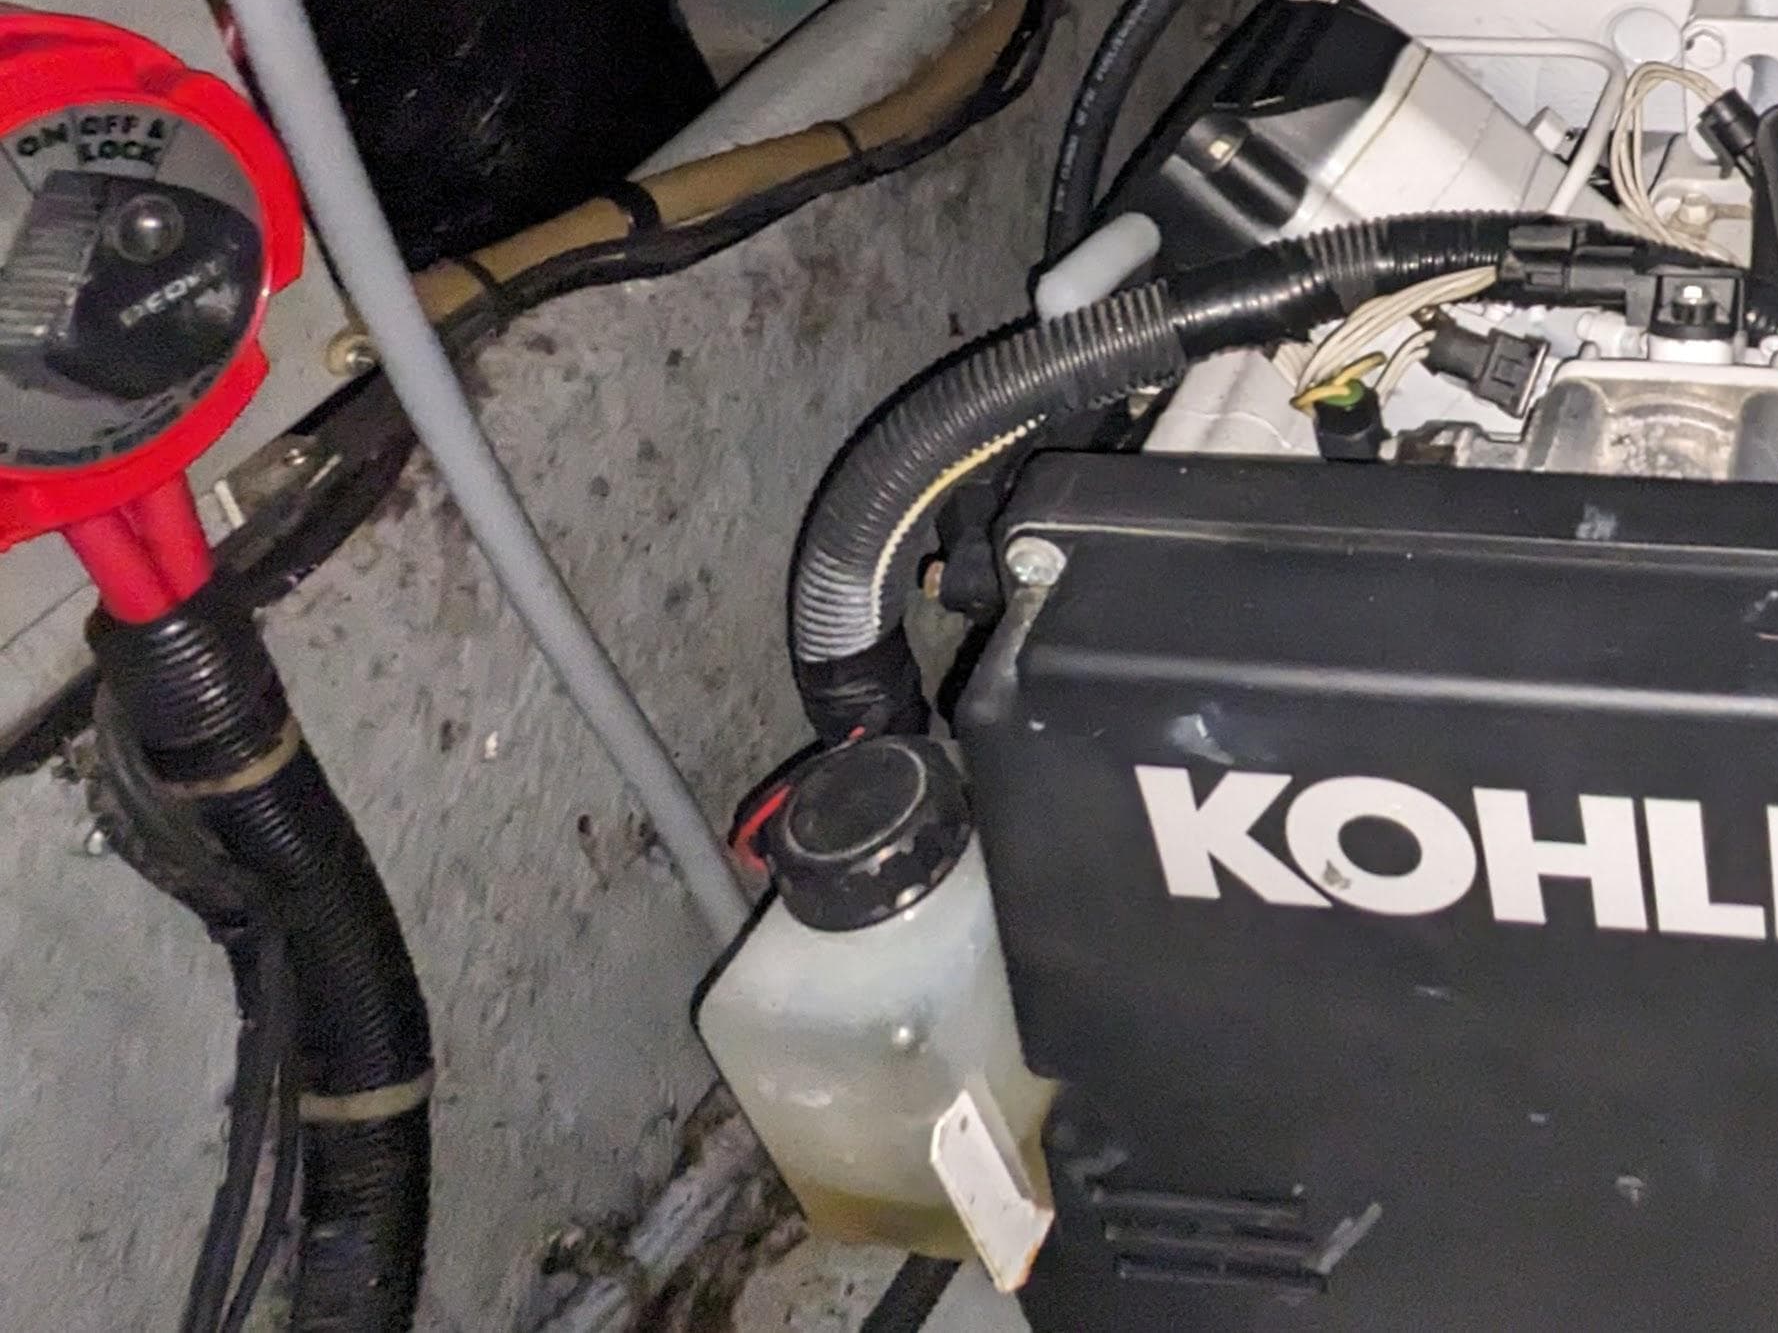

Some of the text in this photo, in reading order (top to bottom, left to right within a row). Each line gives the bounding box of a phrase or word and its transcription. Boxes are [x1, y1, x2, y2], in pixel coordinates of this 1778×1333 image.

[16, 123, 70, 157] ON
[80, 114, 140, 135] OFF
[77, 140, 163, 166] LOCK
